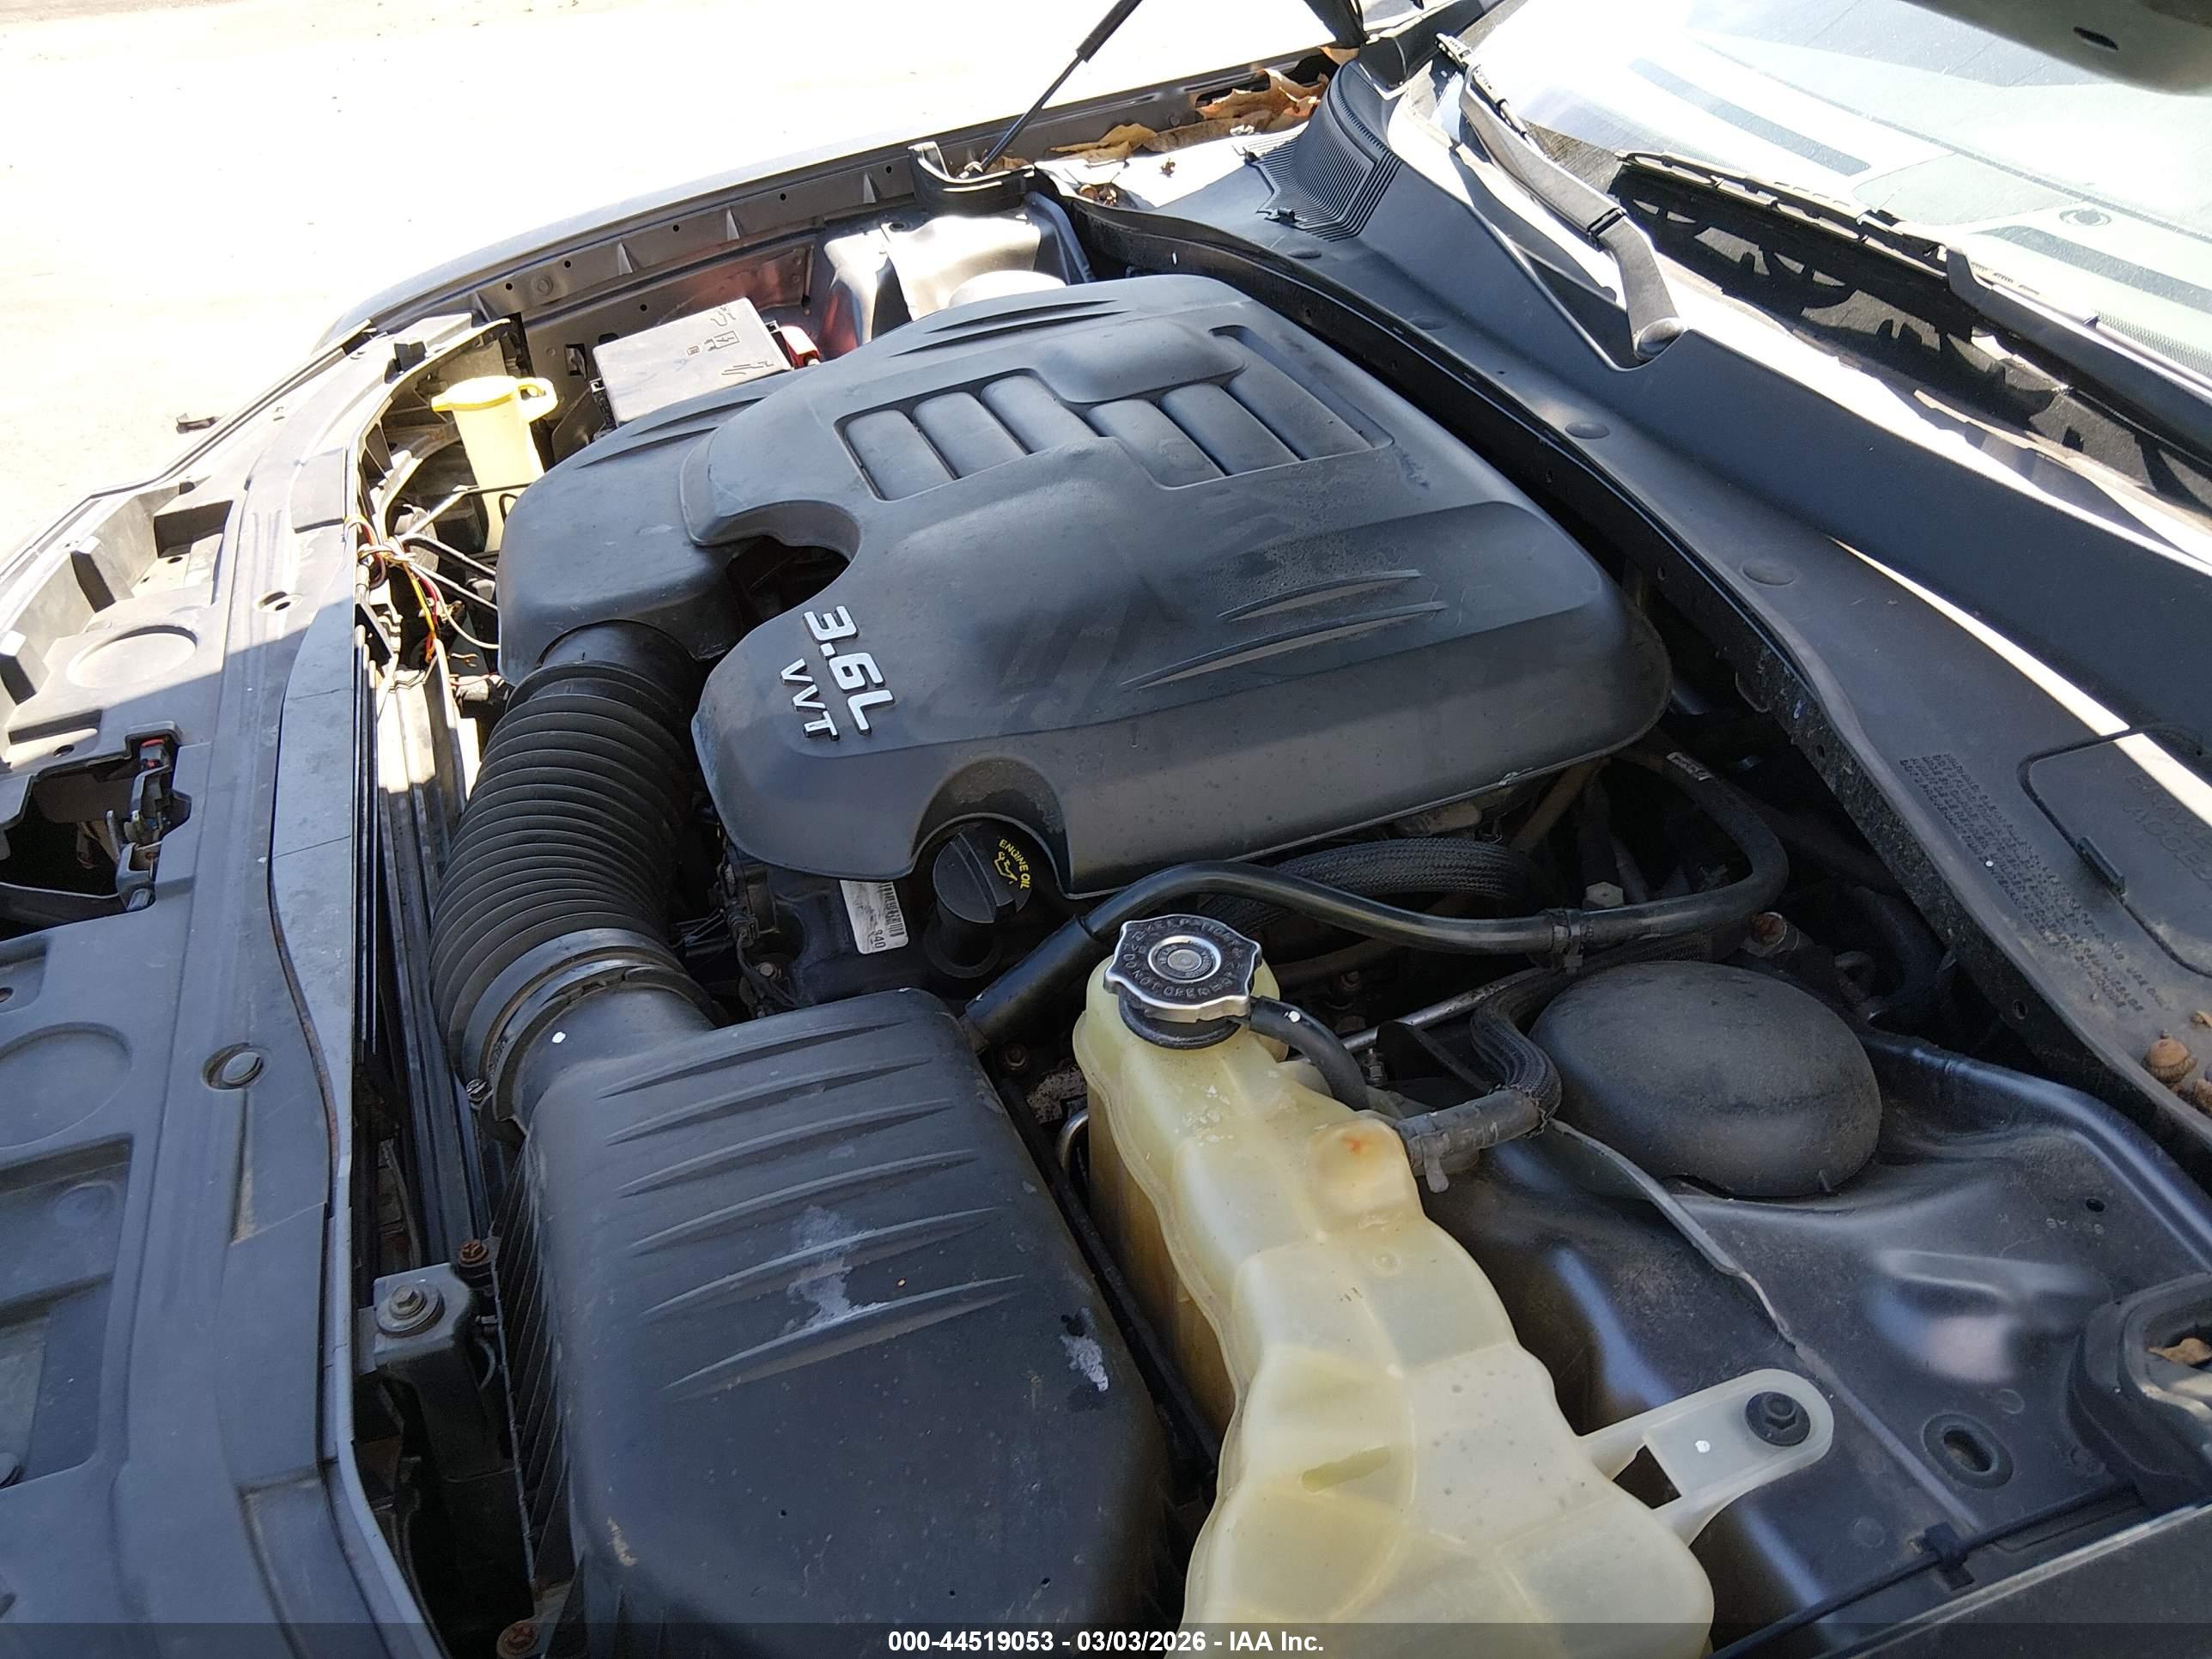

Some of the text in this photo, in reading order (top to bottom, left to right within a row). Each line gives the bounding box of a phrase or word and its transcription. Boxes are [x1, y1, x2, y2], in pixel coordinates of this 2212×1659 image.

[780, 658, 841, 741] VVT
[803, 605, 896, 735] 3.6L
[999, 839, 1031, 890] ENGINE OIL
